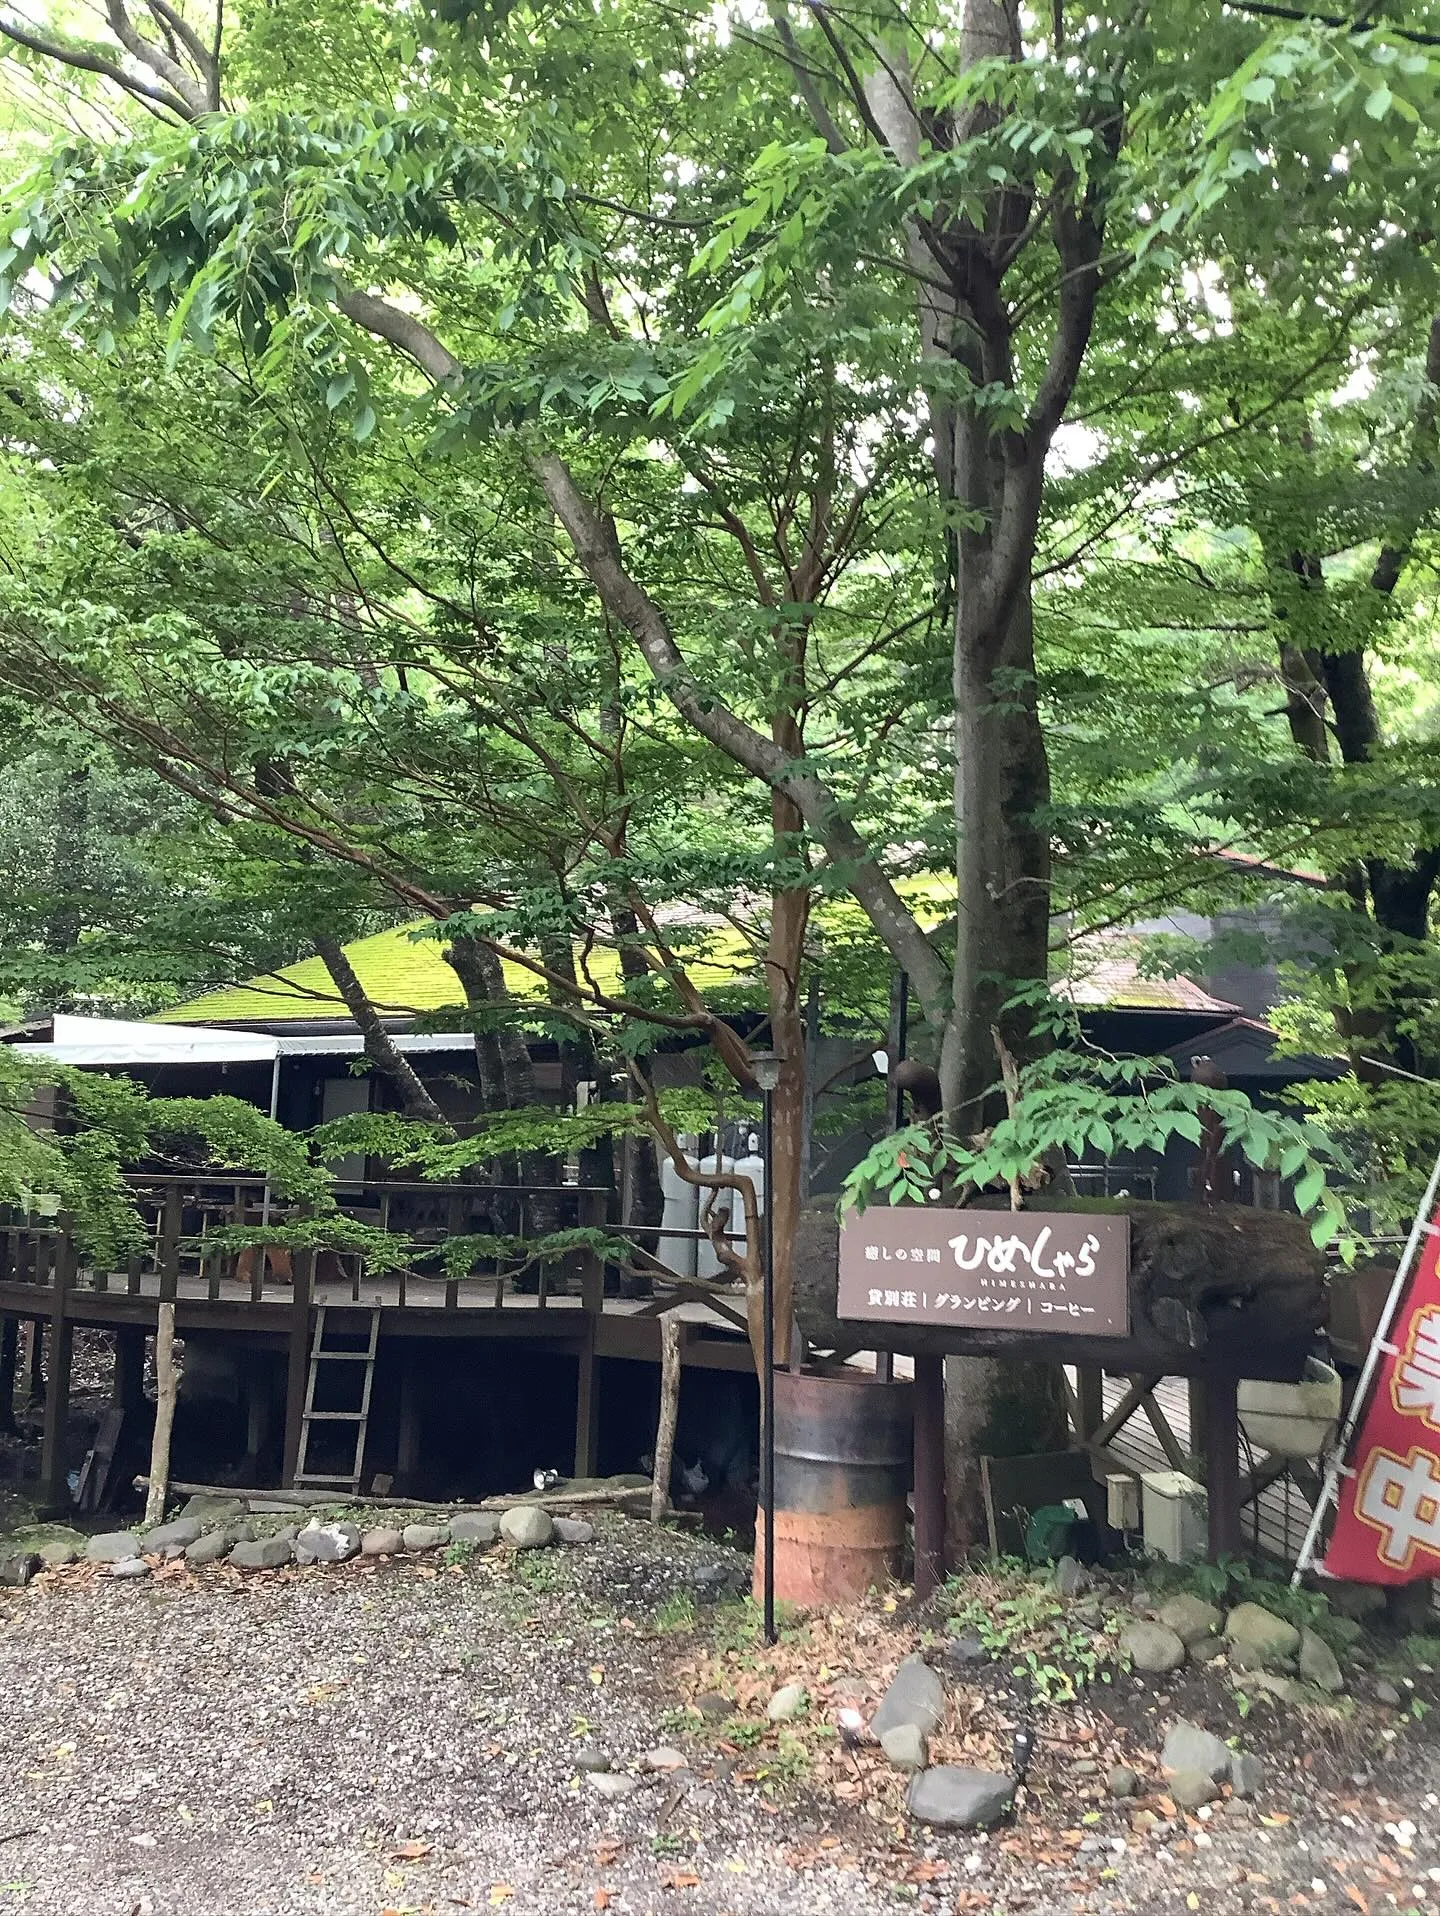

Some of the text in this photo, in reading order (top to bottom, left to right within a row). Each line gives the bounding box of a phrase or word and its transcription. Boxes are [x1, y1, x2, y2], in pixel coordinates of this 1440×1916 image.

[948, 1226, 1100, 1278] ひめしゃら
[980, 1278, 1066, 1291] HIMESHARA
[868, 1288, 1096, 1317] 貸別荘 グランピング コーヒー
